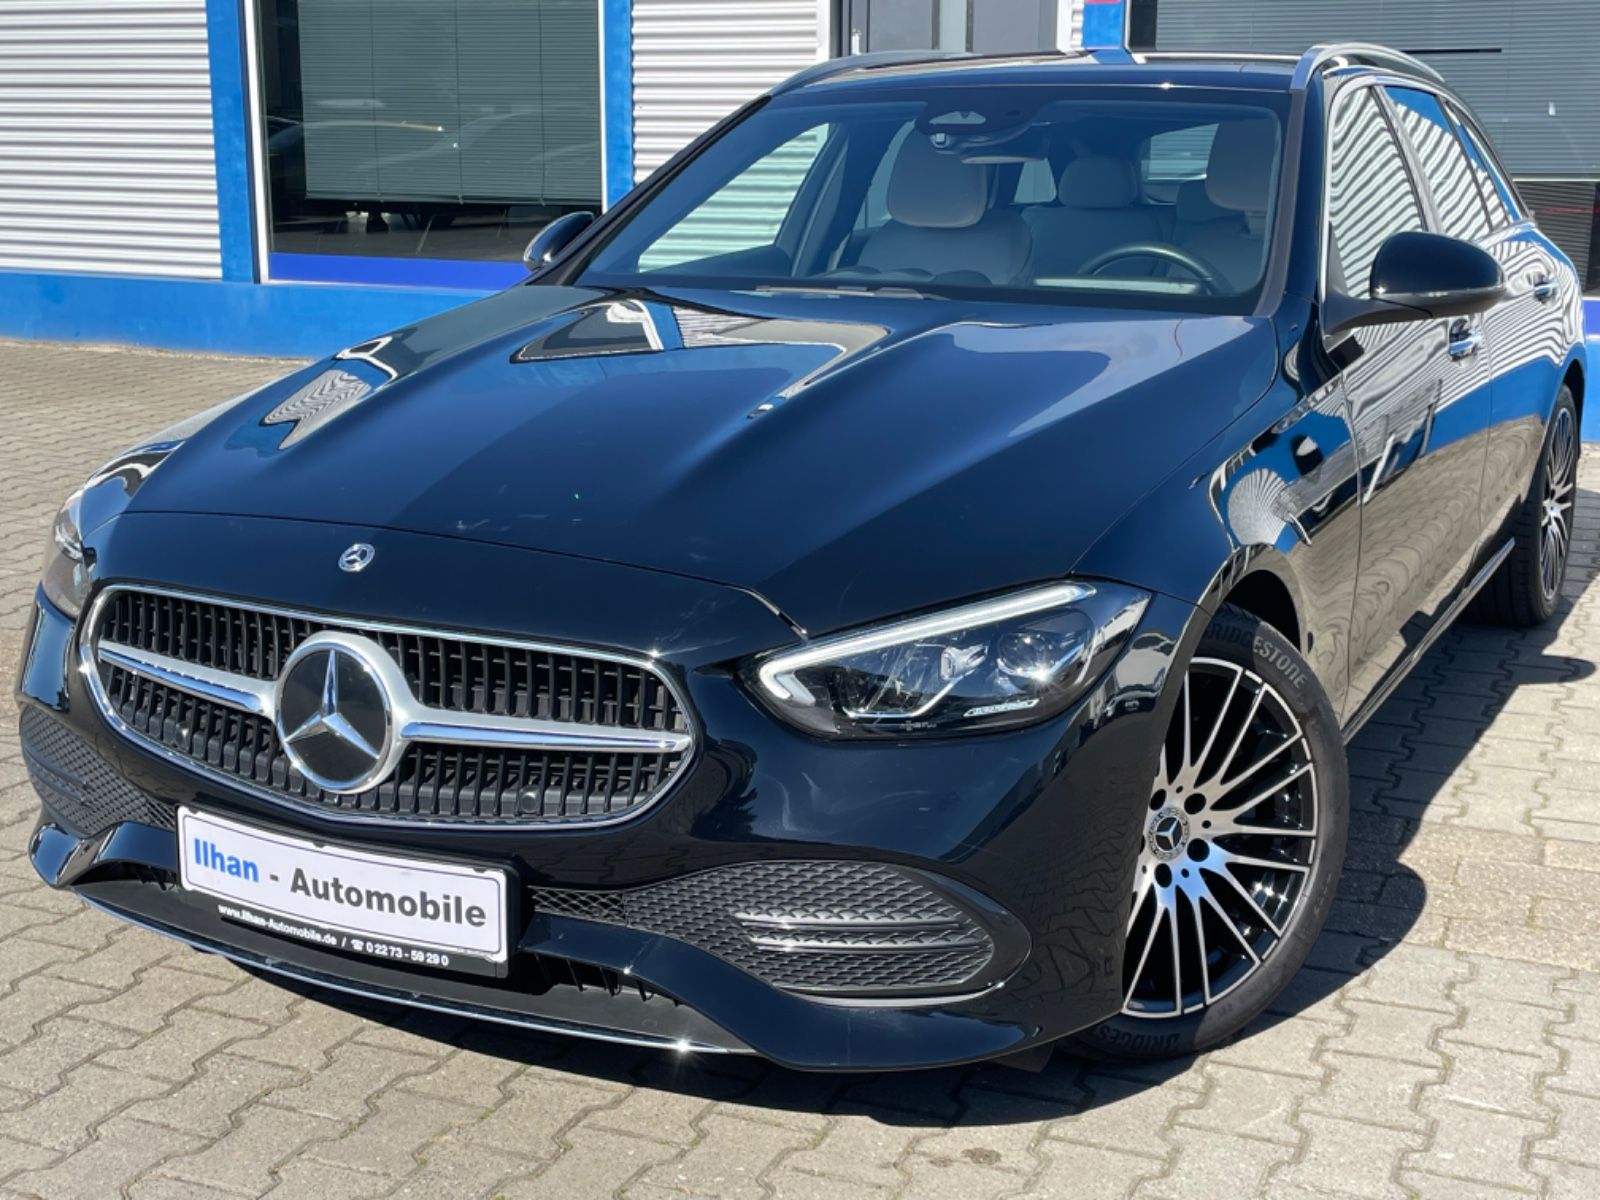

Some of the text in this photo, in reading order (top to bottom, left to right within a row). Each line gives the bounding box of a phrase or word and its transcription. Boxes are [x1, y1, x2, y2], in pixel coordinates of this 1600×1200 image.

[1207, 622, 1309, 689] RIDGESTONE
[194, 838, 487, 928] Ilhan - Automobile
